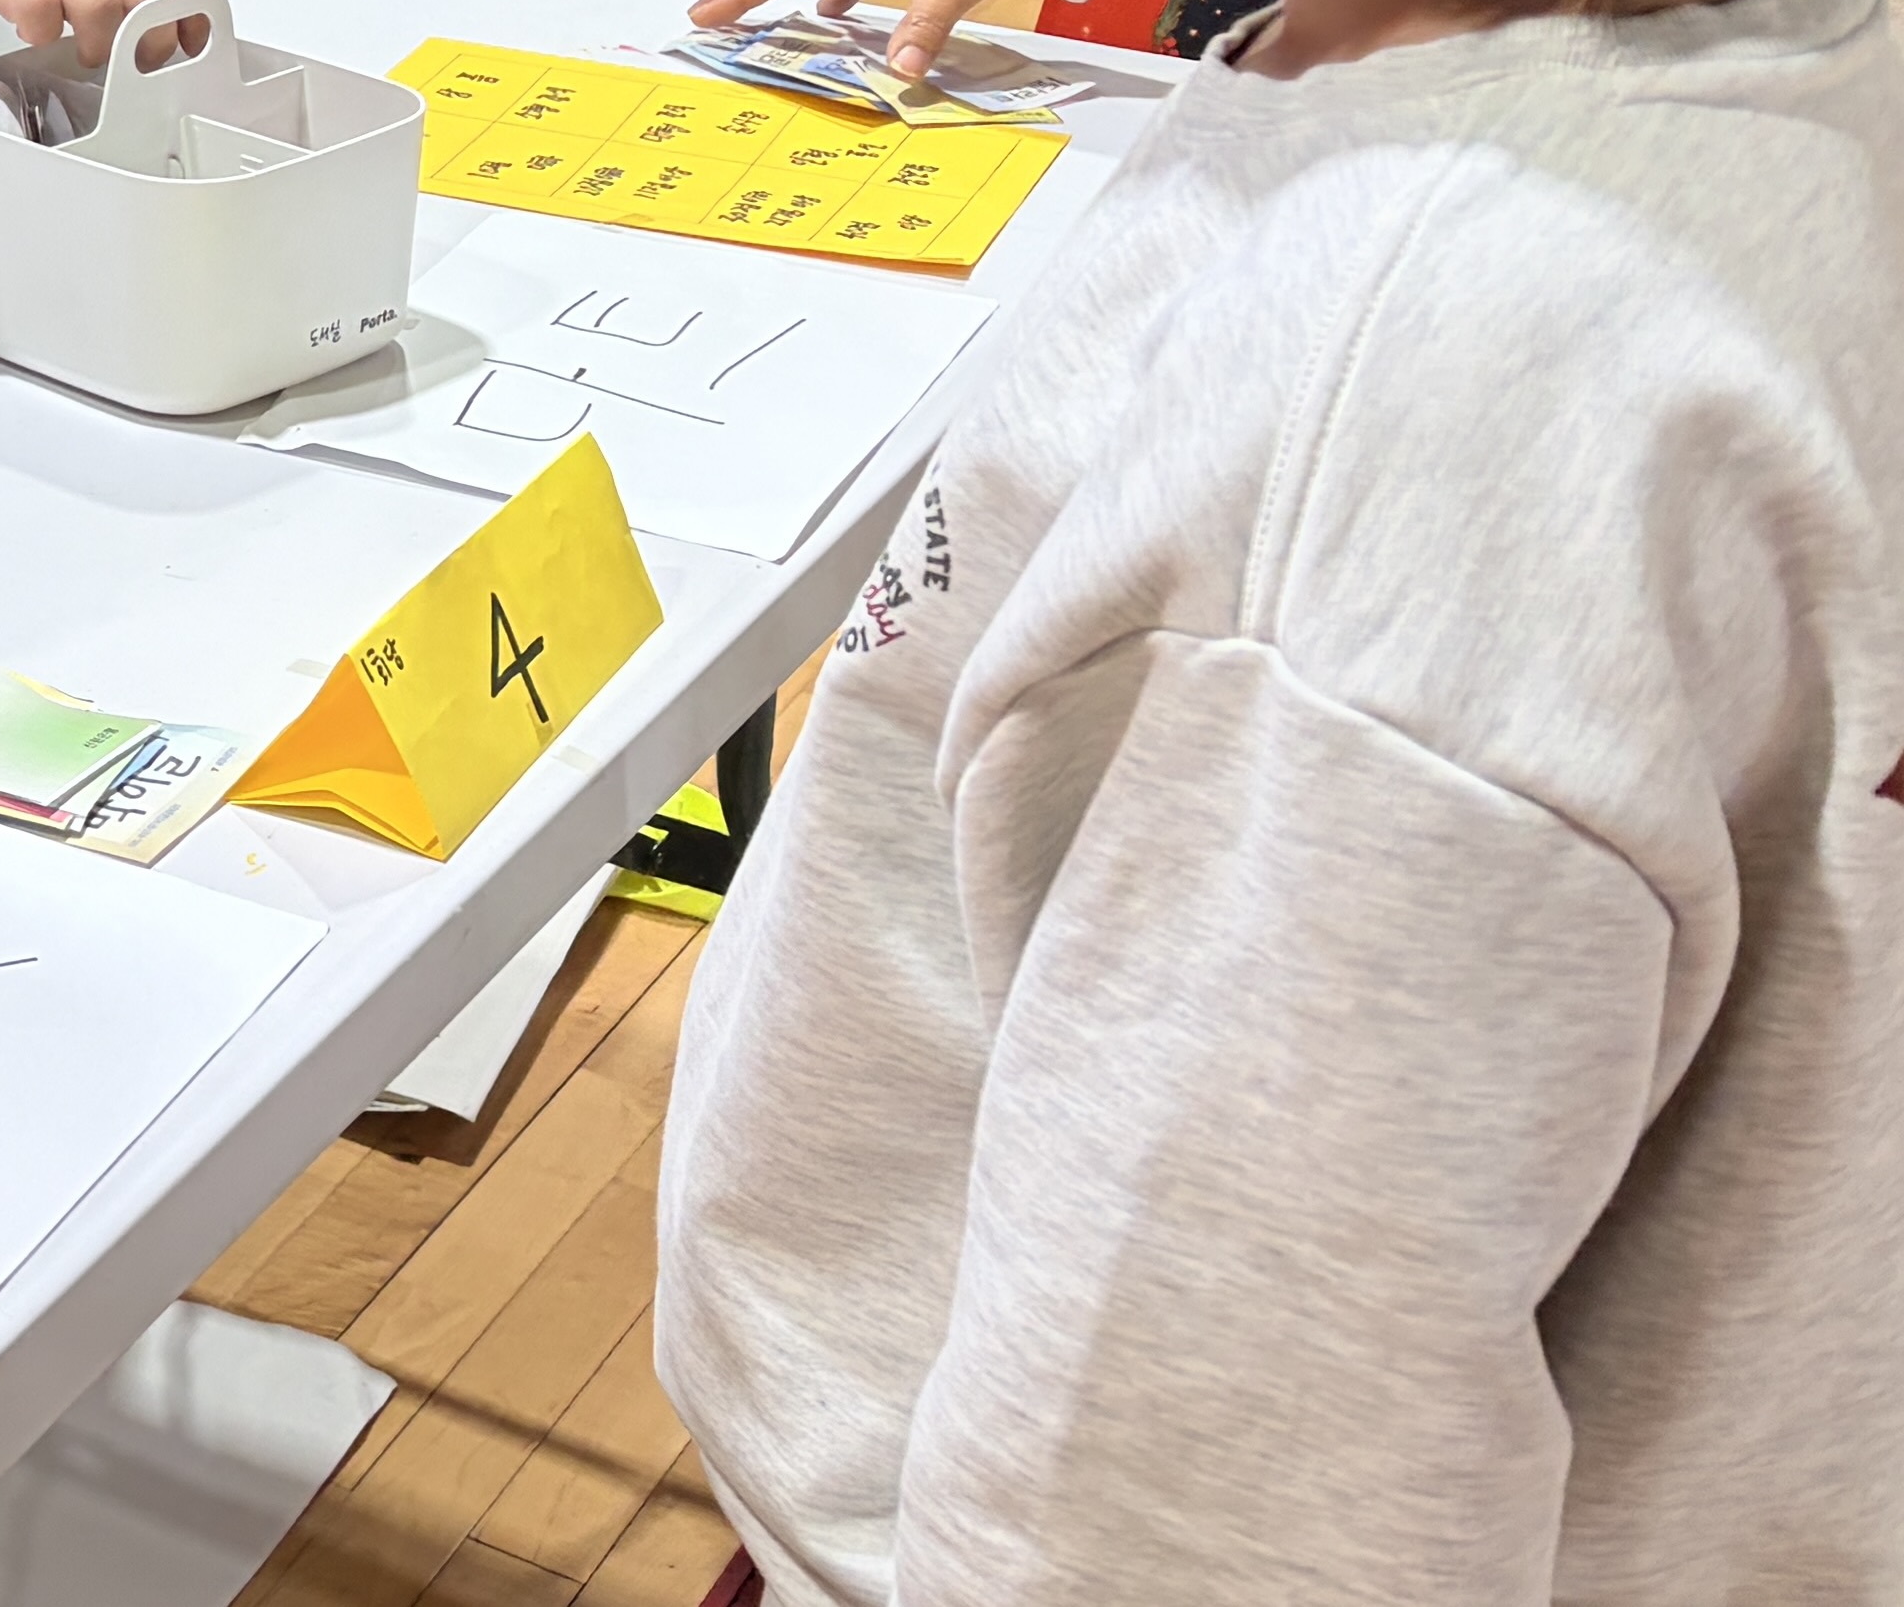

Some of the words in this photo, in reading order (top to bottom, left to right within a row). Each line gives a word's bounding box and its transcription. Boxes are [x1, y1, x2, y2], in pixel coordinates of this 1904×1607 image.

[454, 288, 809, 444] 다트
[923, 486, 952, 593] STATE
[490, 591, 550, 724] 4
